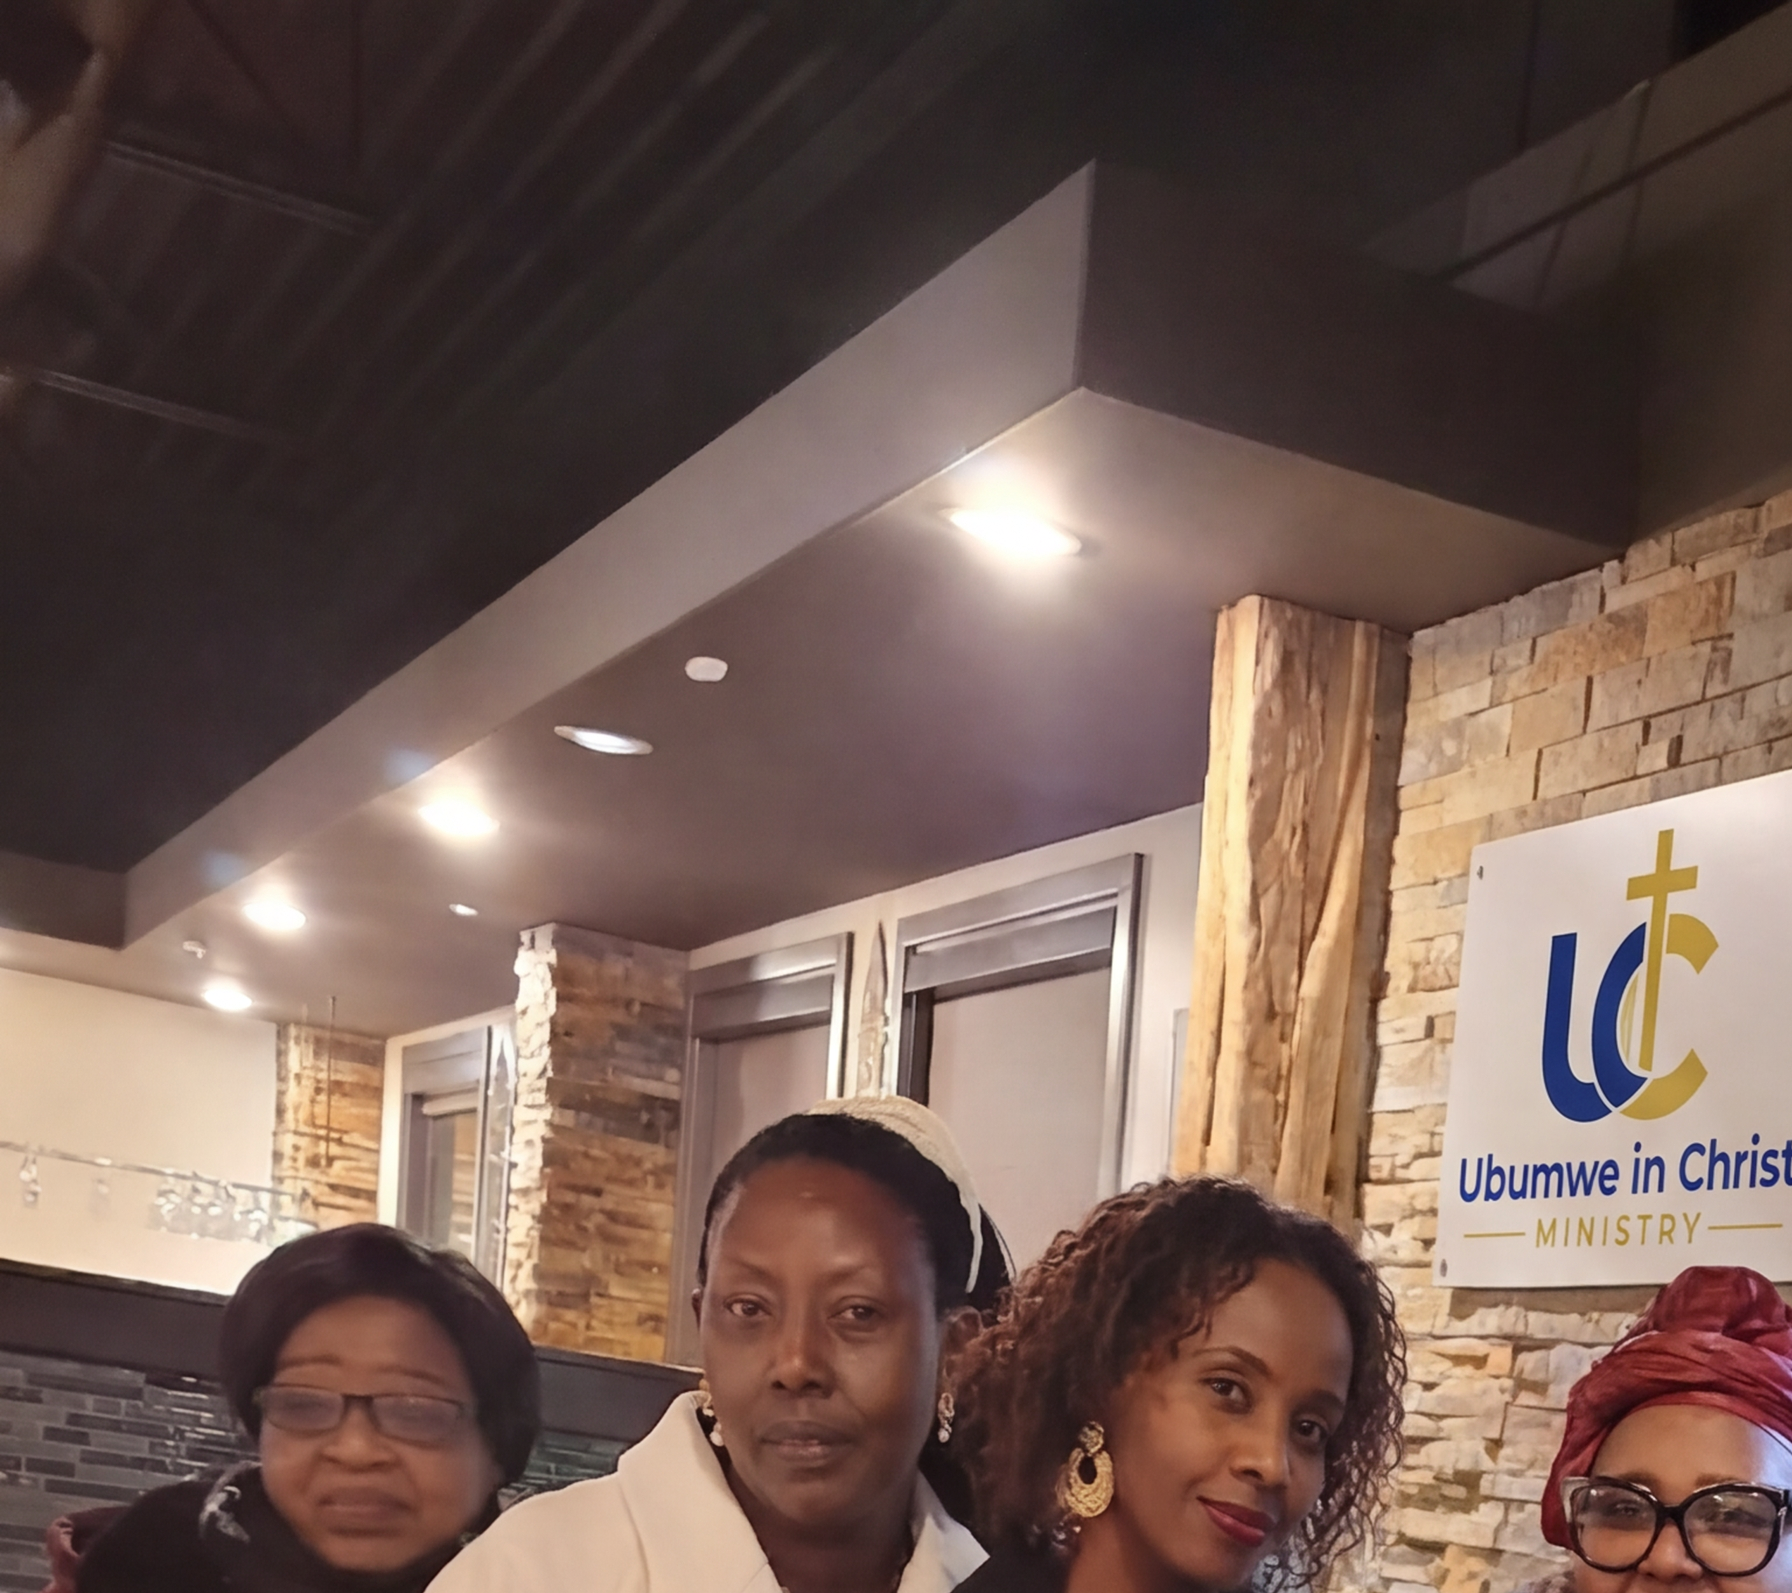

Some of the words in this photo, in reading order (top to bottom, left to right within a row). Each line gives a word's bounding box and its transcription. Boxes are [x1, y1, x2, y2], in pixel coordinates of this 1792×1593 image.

[1459, 1153, 1620, 1203] Ubumwe
[1631, 1141, 1666, 1194] in
[1535, 1212, 1702, 1248] MINISTRY
